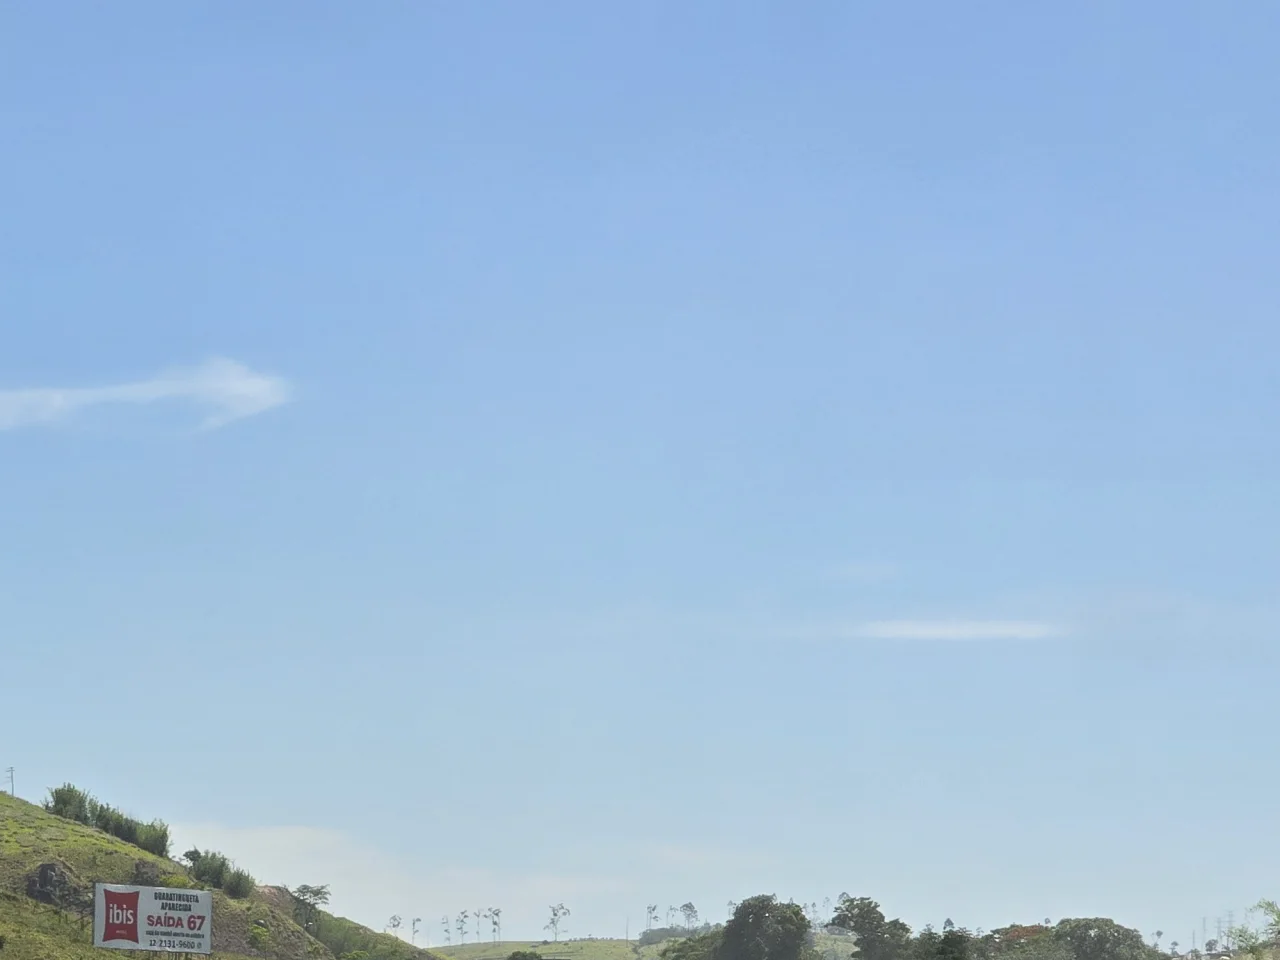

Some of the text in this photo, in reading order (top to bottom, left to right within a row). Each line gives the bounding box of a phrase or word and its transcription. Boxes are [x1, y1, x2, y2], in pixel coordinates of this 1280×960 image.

[160, 902, 192, 911] APARECIDA
[109, 904, 134, 925] ibis
[147, 912, 206, 931] SAÍDA 67
[159, 940, 195, 949] 2131-9600
